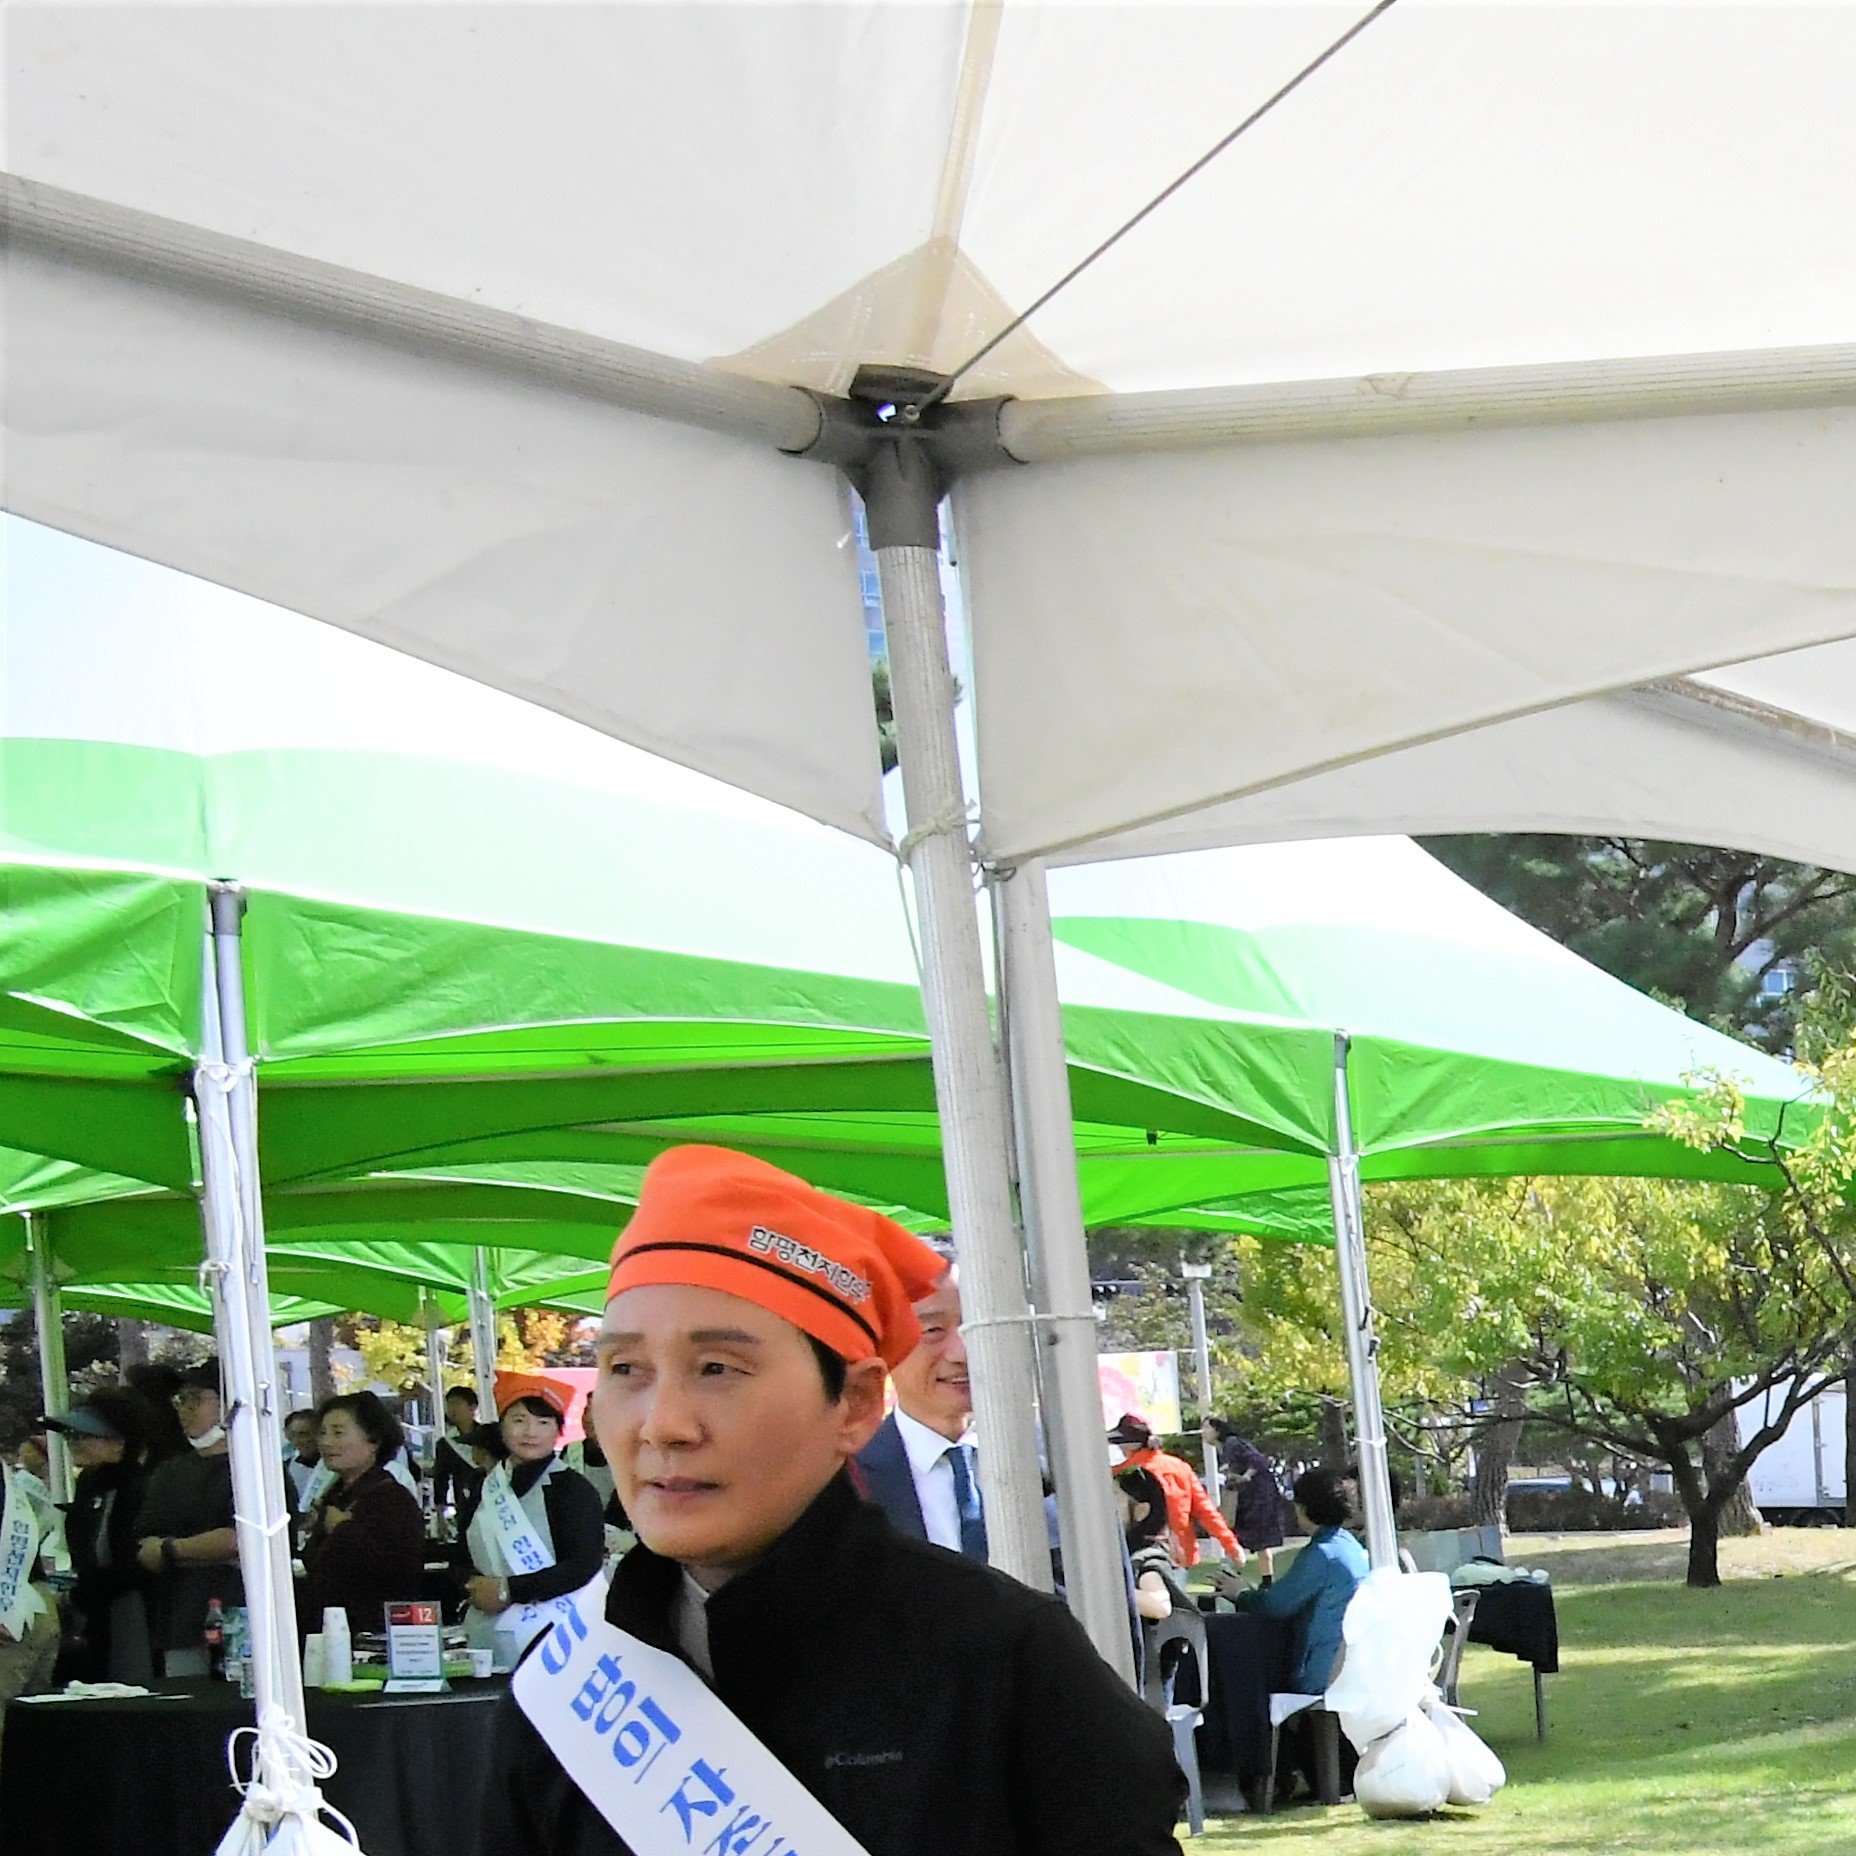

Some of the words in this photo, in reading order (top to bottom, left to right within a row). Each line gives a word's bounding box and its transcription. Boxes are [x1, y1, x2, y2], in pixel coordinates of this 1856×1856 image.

[750, 1227, 872, 1299] 함평천지한우
[417, 1607, 433, 1623] 12
[541, 1597, 588, 1675] 이
[570, 1653, 682, 1785] 땅의
